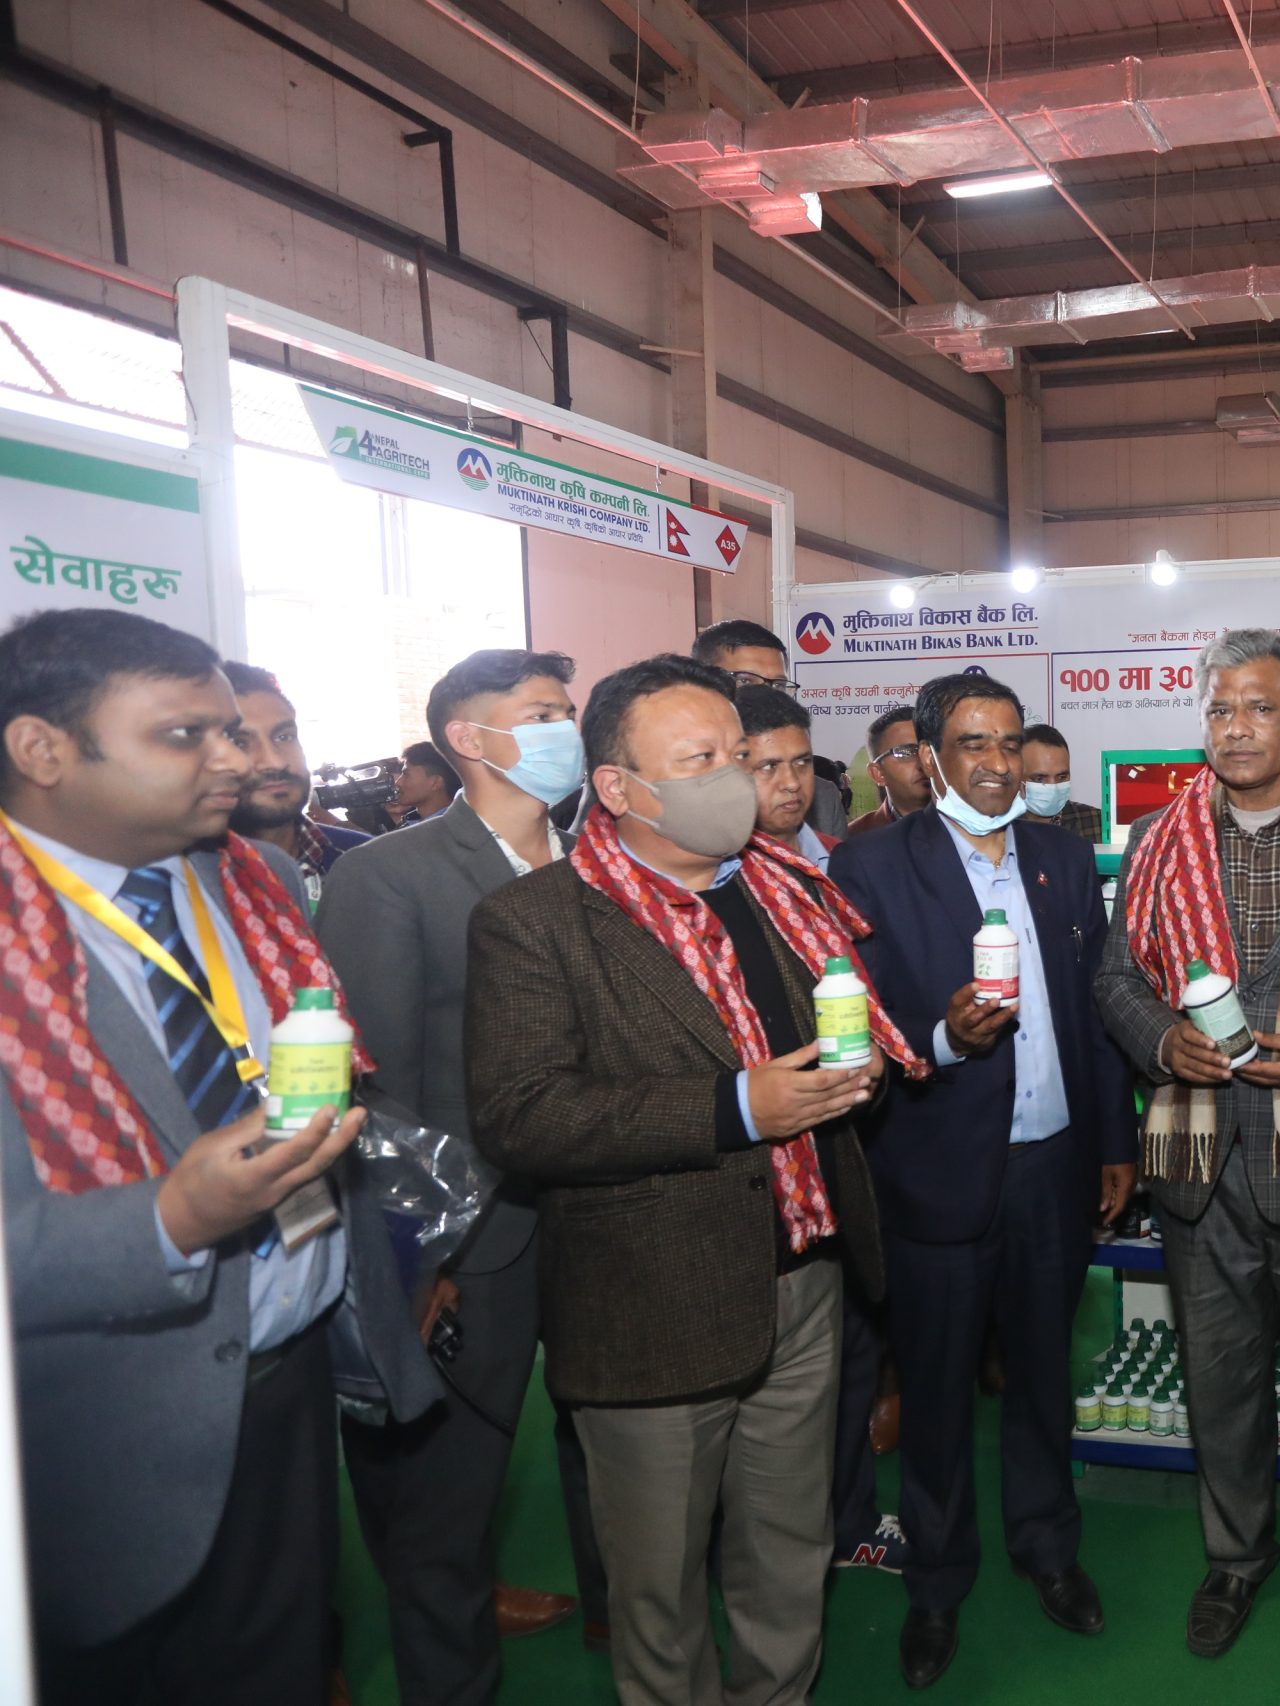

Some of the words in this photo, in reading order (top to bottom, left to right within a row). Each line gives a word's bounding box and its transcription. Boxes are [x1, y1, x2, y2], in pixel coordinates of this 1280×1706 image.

[375, 436, 400, 450] NEPAL
[376, 448, 430, 471] AGRITECH
[497, 462, 555, 492] मुक्तिनाथ
[560, 480, 586, 501] कृषि
[590, 491, 630, 512] कम्पनी
[633, 498, 650, 518] लि.
[497, 483, 555, 509] MUKTINATH
[557, 497, 587, 517] KRISHI
[590, 509, 635, 529] COMPANY
[635, 521, 650, 534] LTD.
[720, 540, 736, 551] A35
[9, 535, 182, 605] सेवाहरू
[843, 610, 913, 633] मुक्तिनाथ
[919, 607, 972, 628] विकास
[977, 604, 1006, 624] बैंक
[1012, 602, 1038, 623] लि.
[843, 638, 917, 653] MUKTINATH
[921, 635, 961, 650] BIKAS
[966, 633, 1003, 648] BANK
[1060, 668, 1110, 692] १००
[1119, 666, 1153, 690] मा
[801, 688, 828, 699] असल
[831, 685, 852, 700] कृषि
